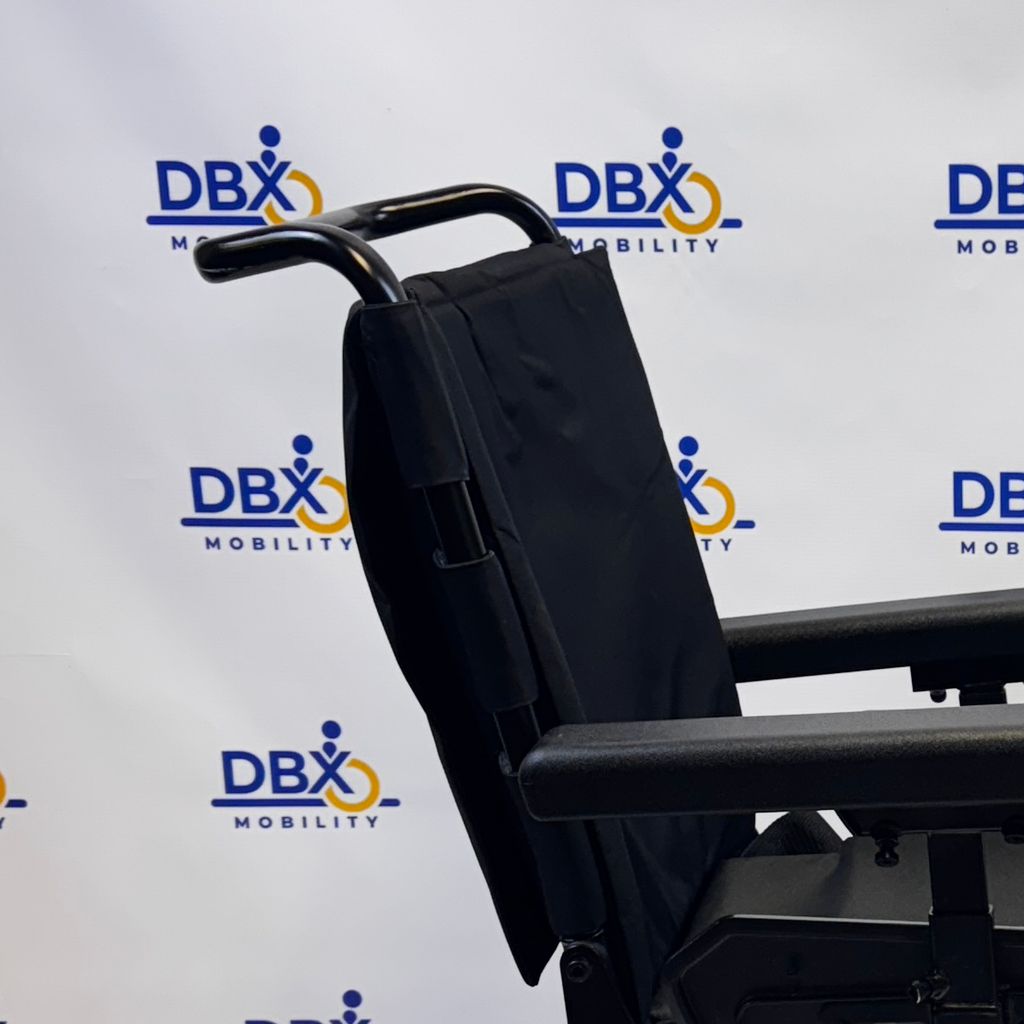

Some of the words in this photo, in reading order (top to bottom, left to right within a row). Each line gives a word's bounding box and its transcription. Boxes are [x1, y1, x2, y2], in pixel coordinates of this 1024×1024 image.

[157, 160, 296, 212] DBX
[555, 162, 696, 214] DBX
[568, 238, 719, 253] MOBILITY
[190, 466, 328, 516] DBX
[204, 537, 353, 551] MOBILITY
[222, 750, 355, 796] DBX
[233, 816, 380, 829] MOBILITY
